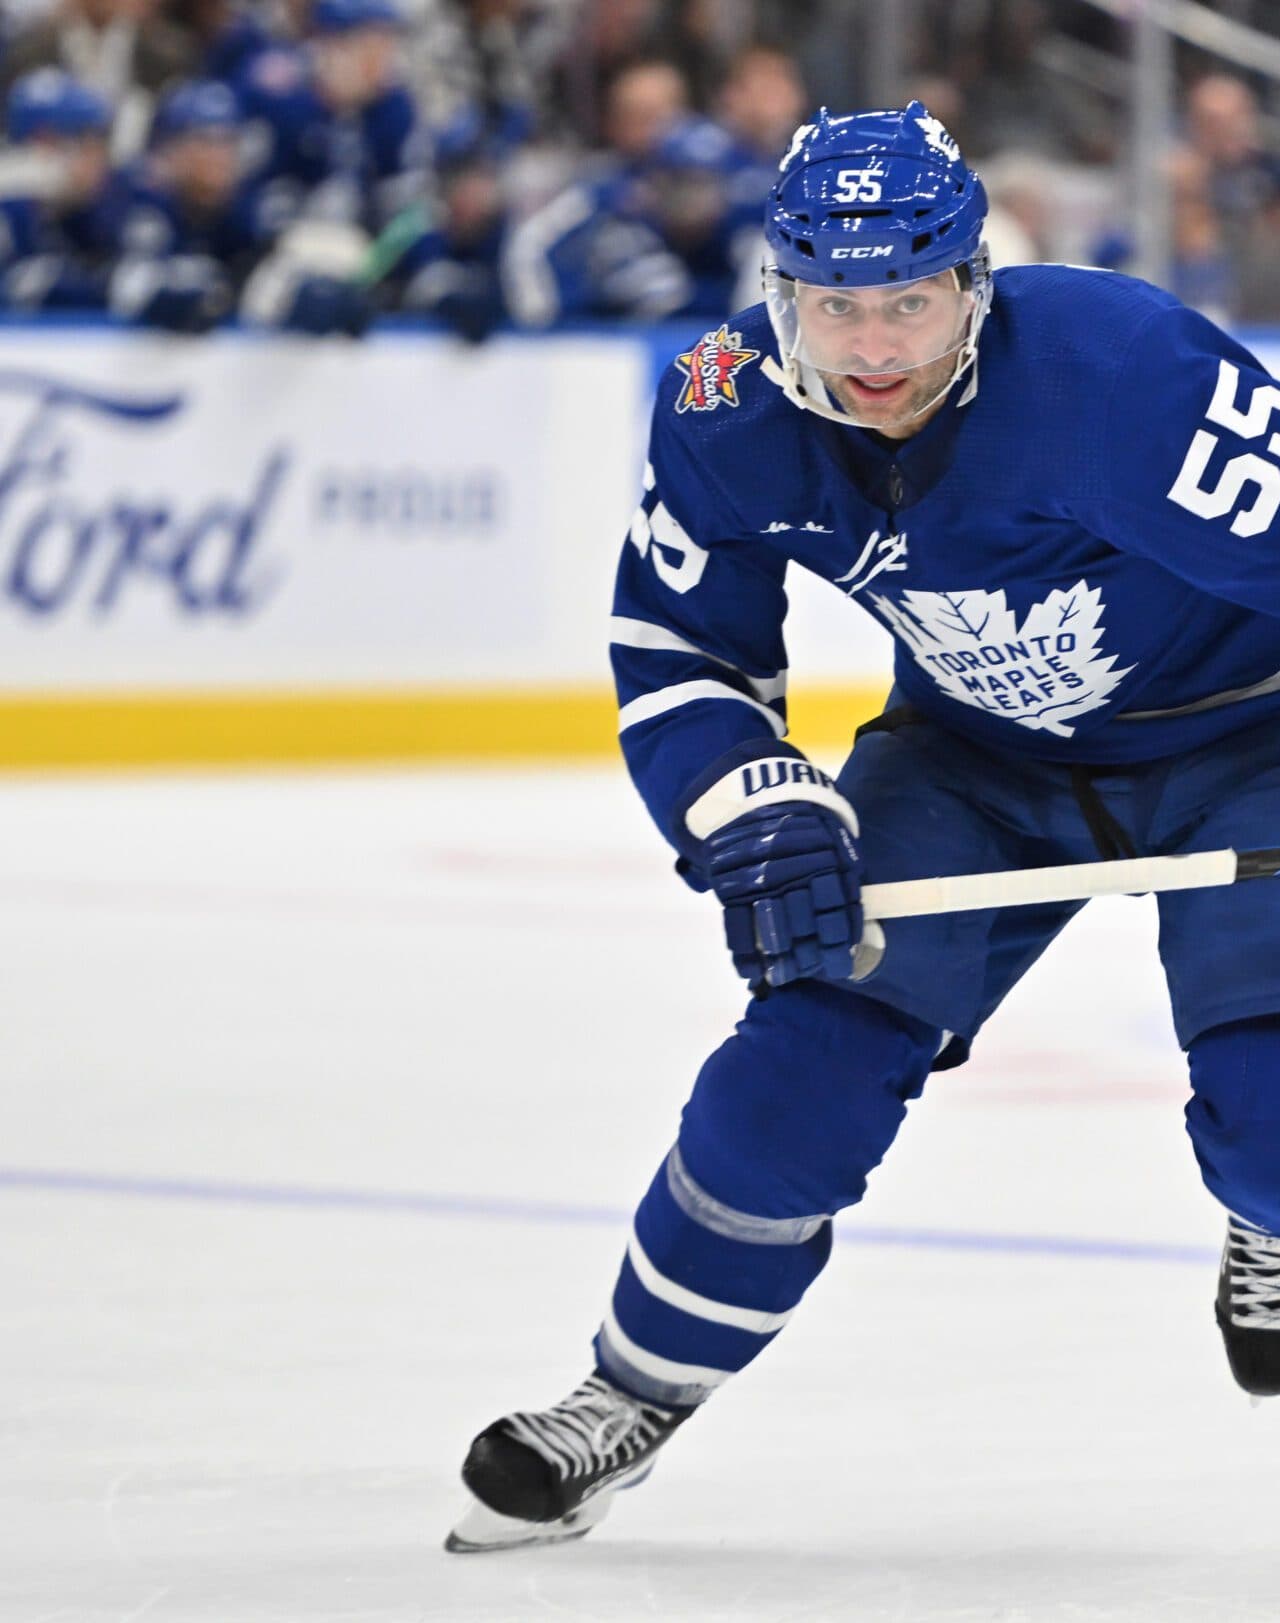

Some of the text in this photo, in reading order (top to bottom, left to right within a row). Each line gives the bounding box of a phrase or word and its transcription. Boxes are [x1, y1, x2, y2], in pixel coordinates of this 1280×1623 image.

[832, 169, 884, 203] 55
[830, 245, 894, 260] CCM
[925, 632, 1077, 677] TORONTO
[958, 655, 1070, 693] MAPLE
[974, 671, 1085, 710] LEAFS
